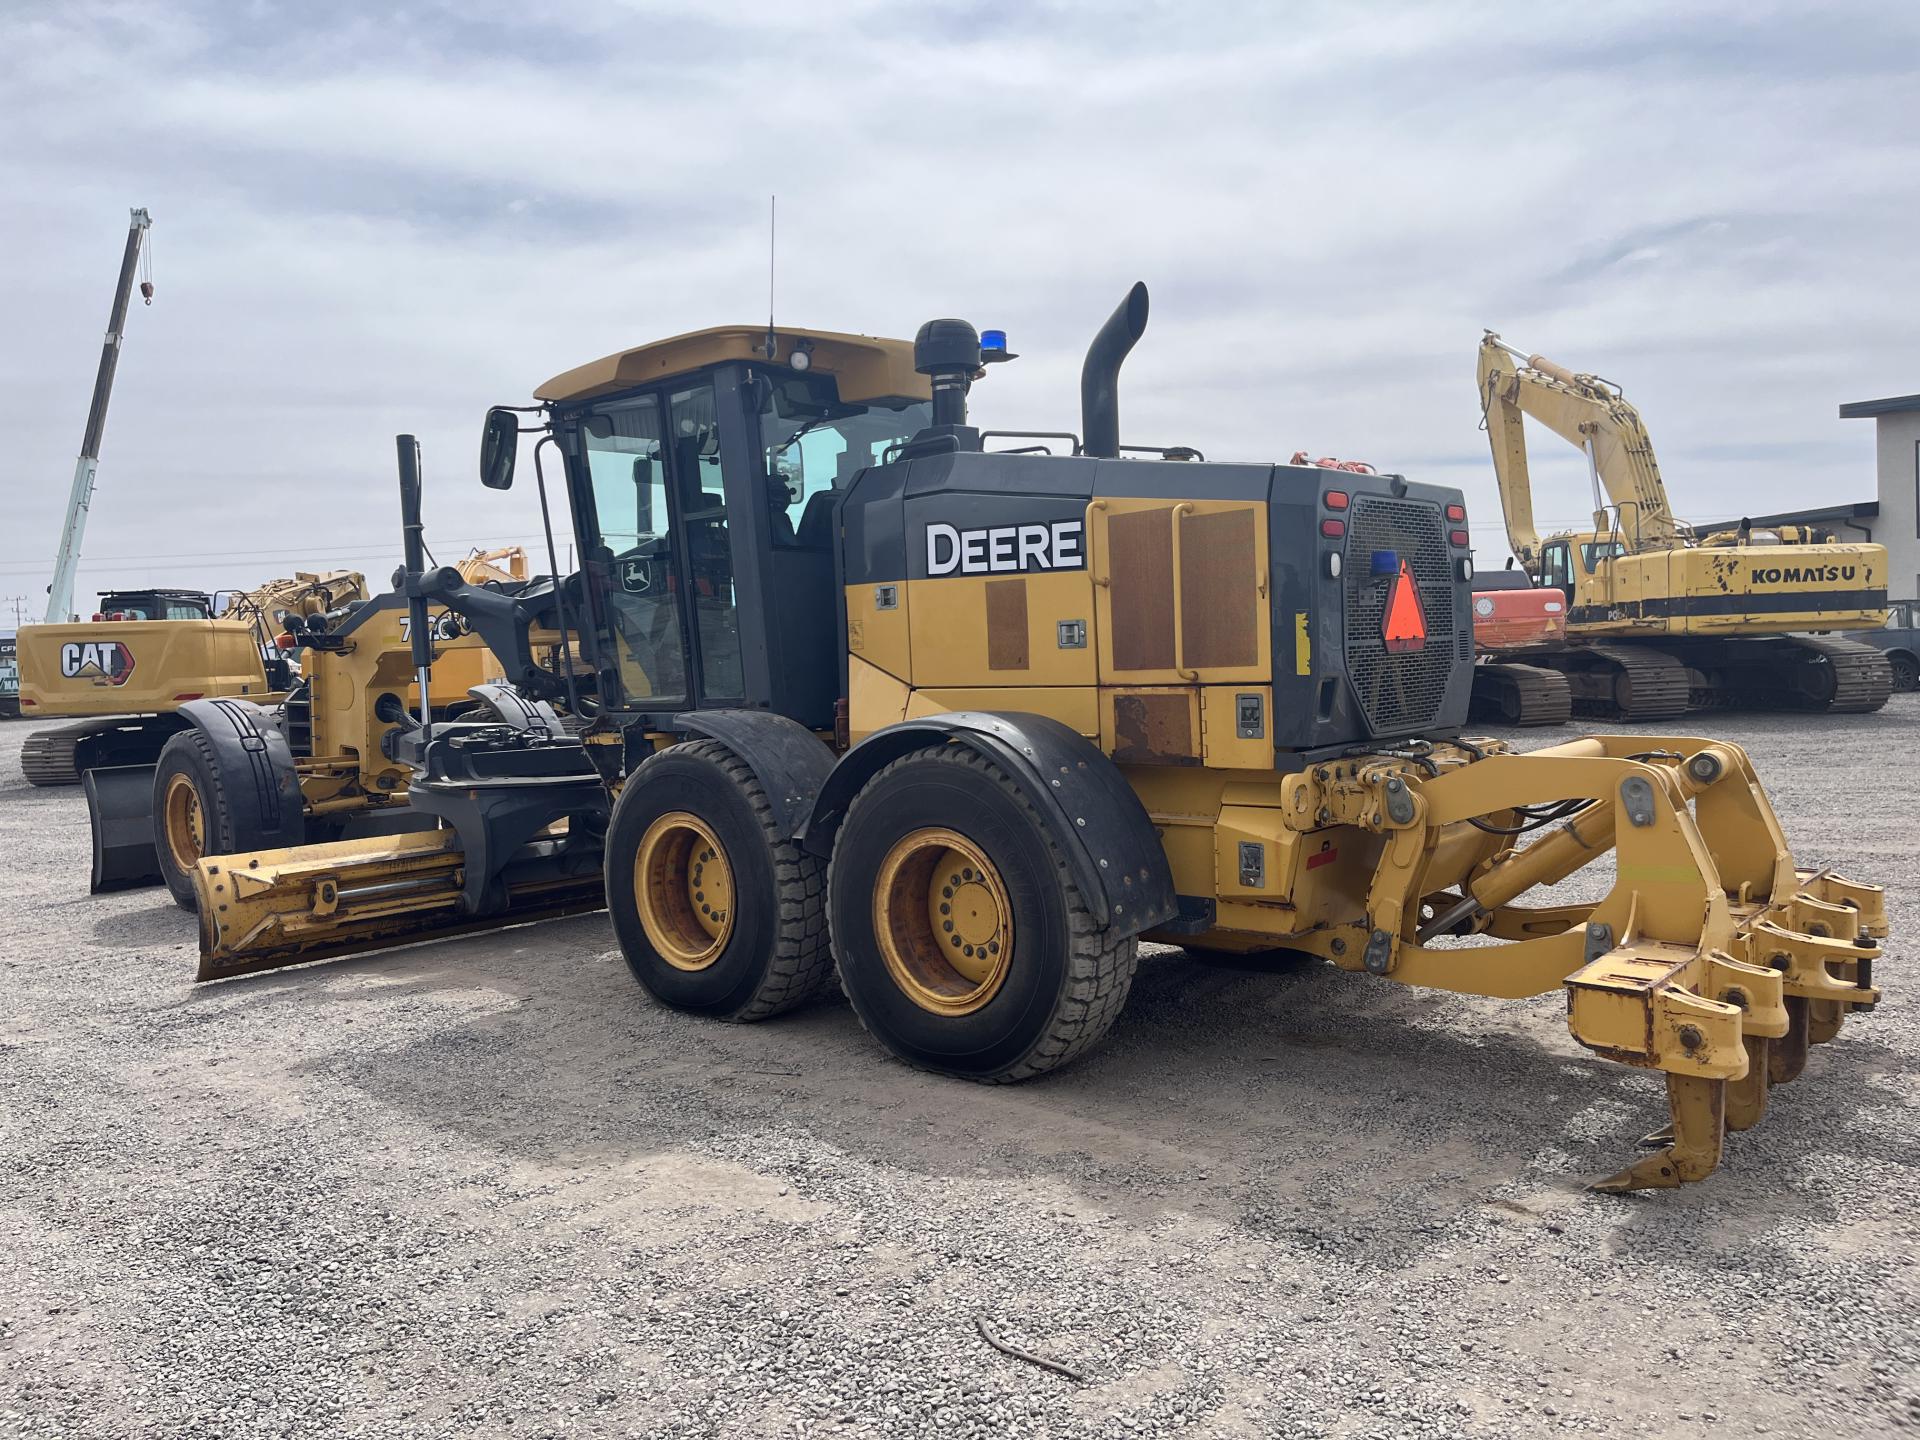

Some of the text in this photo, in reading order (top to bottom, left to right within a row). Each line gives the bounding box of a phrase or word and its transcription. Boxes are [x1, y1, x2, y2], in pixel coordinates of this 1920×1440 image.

[926, 520, 1083, 575] DEERE
[1751, 565, 1856, 584] KOMATSU
[62, 643, 116, 677] CAT
